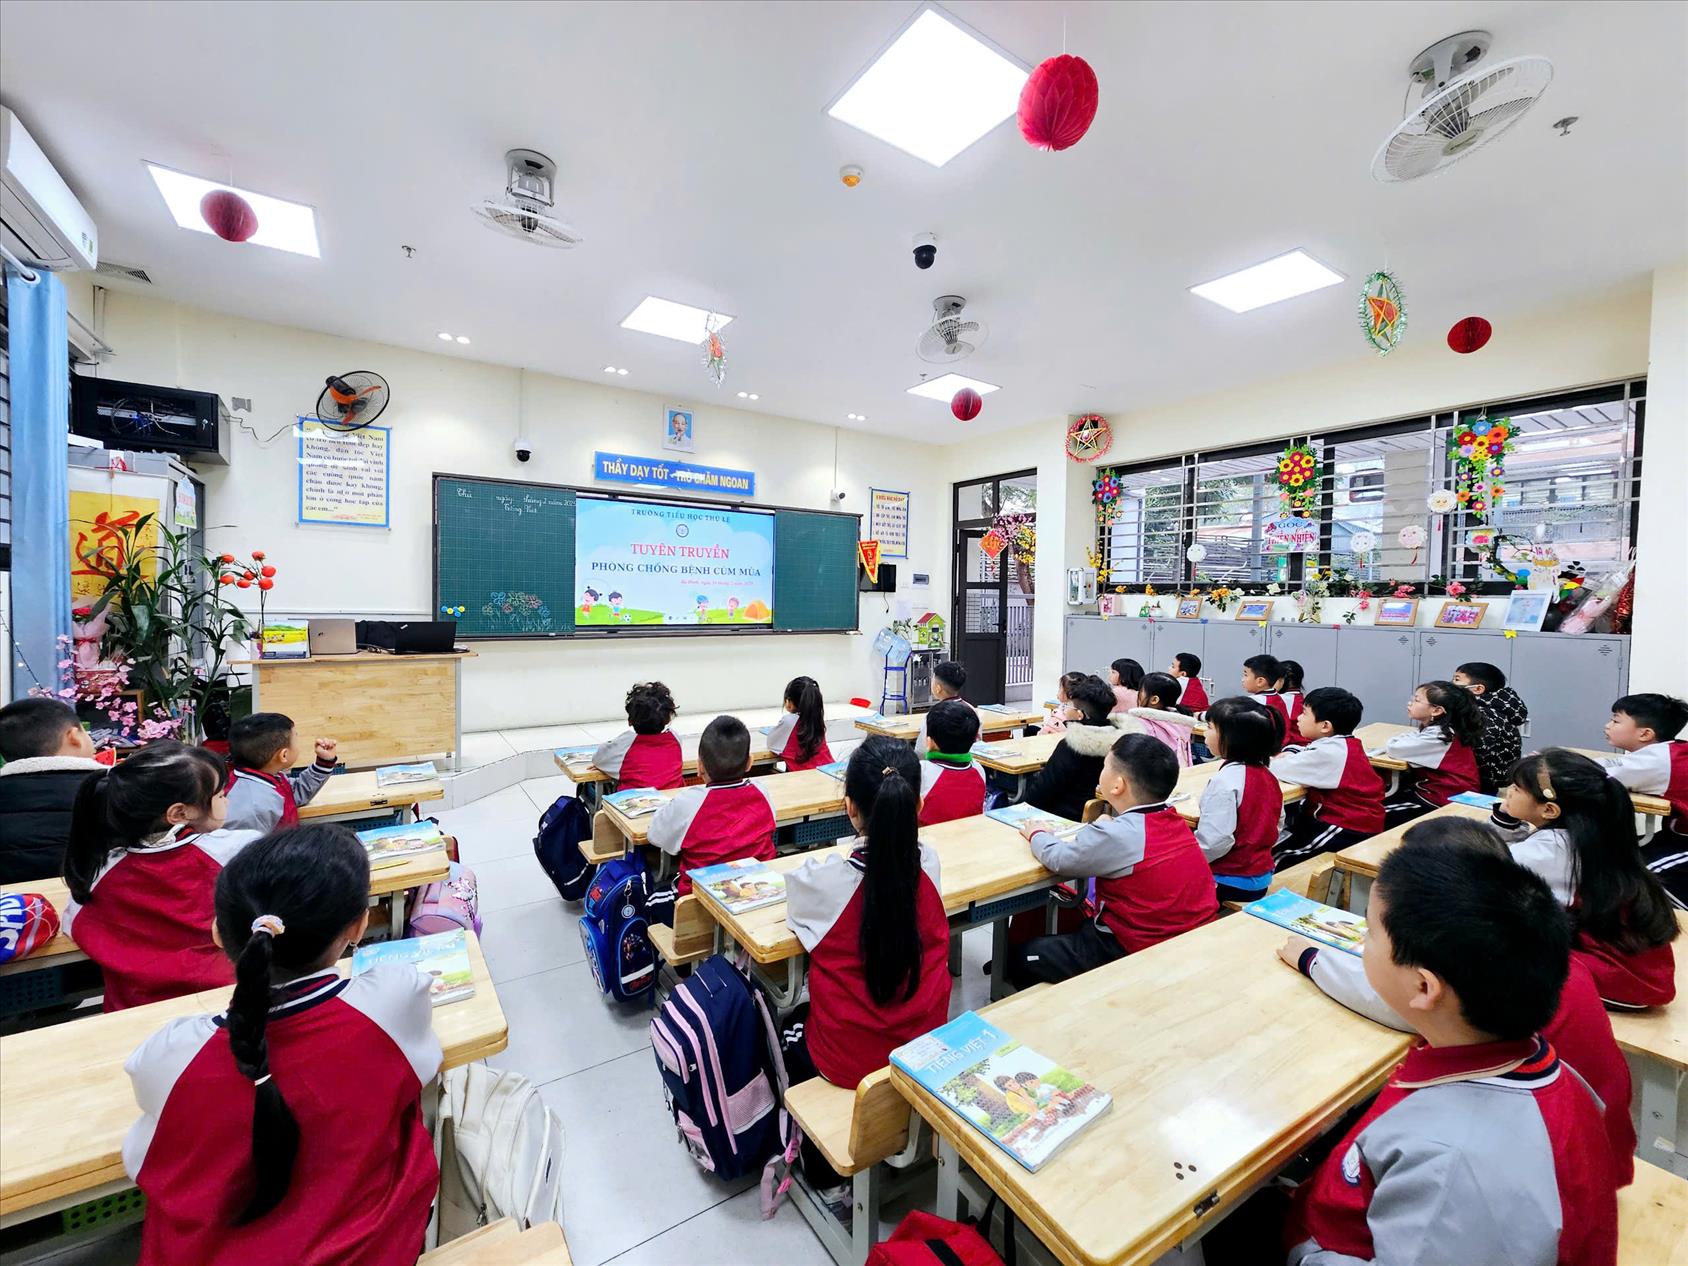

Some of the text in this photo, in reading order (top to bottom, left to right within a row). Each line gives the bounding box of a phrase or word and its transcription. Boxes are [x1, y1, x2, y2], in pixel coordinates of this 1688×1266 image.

[602, 457, 627, 475] THẦY
[629, 464, 650, 481] DẠY
[652, 463, 669, 480] TỐT
[720, 475, 749, 490] NGOAN
[630, 542, 730, 560] TUYÊN TRUYỀN
[591, 560, 634, 572] PHÒNG
[637, 561, 678, 574] CHỐNG
[983, 1029, 999, 1040] 1
